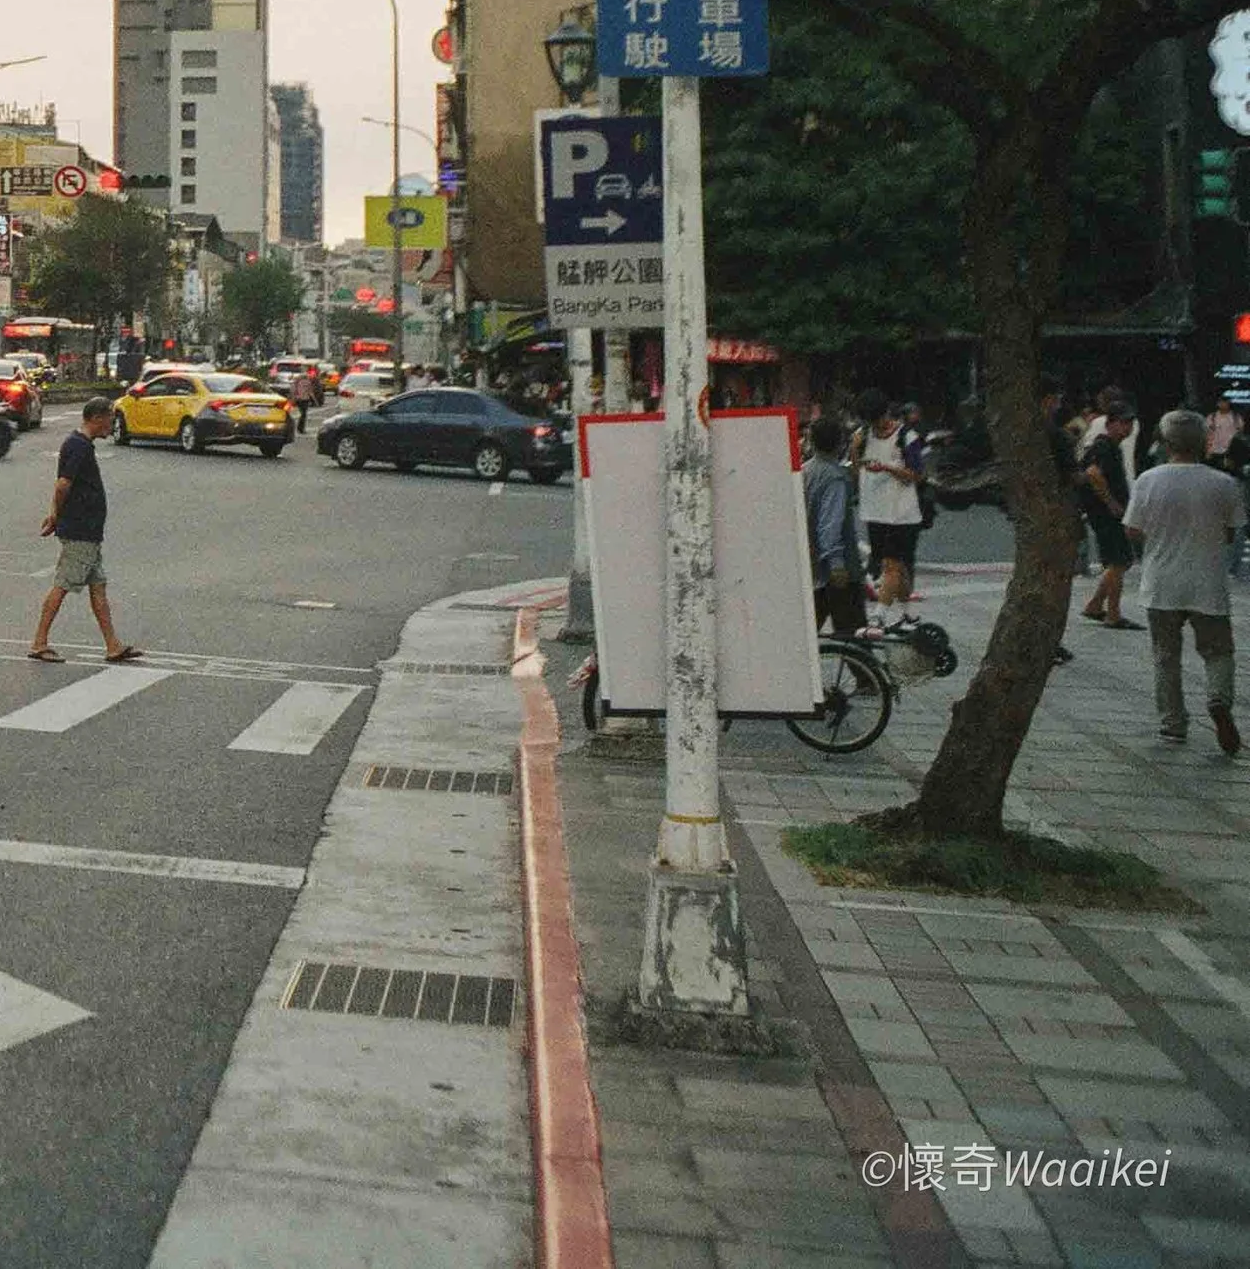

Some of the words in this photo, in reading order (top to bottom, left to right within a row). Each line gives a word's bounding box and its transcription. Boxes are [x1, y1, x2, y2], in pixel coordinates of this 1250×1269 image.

[550, 130, 609, 199] P
[557, 256, 664, 286] 艋舺公園
